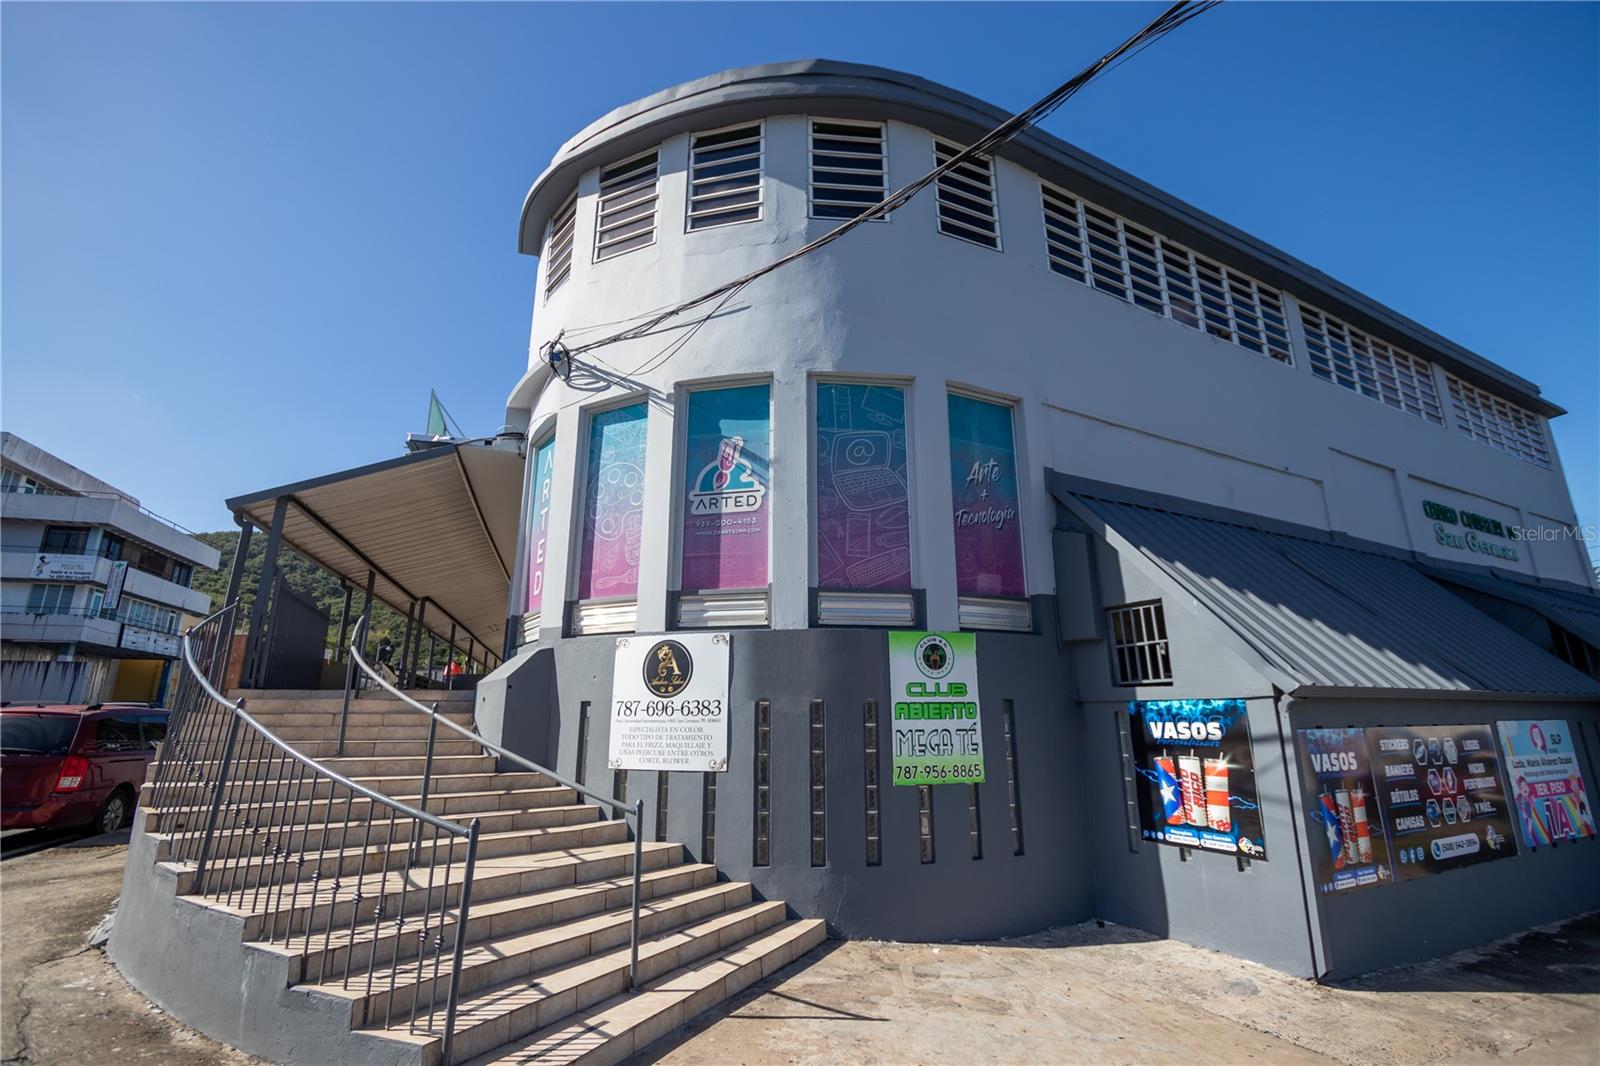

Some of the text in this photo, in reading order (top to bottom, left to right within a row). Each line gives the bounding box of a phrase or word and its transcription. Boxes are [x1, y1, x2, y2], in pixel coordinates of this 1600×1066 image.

[965, 458, 1001, 488] Arte
[695, 494, 758, 510] ARTED
[1433, 522, 1465, 550] San
[906, 682, 967, 697] CLUB
[616, 700, 721, 717] 787-696-6383
[895, 702, 977, 720] ABIERTO
[896, 722, 979, 757] MEGA TÉ
[1149, 721, 1222, 740] VASOS
[1311, 752, 1358, 773] VASOS
[896, 764, 982, 780] 787-956-8865
[1395, 815, 1425, 831] CAMISAS
